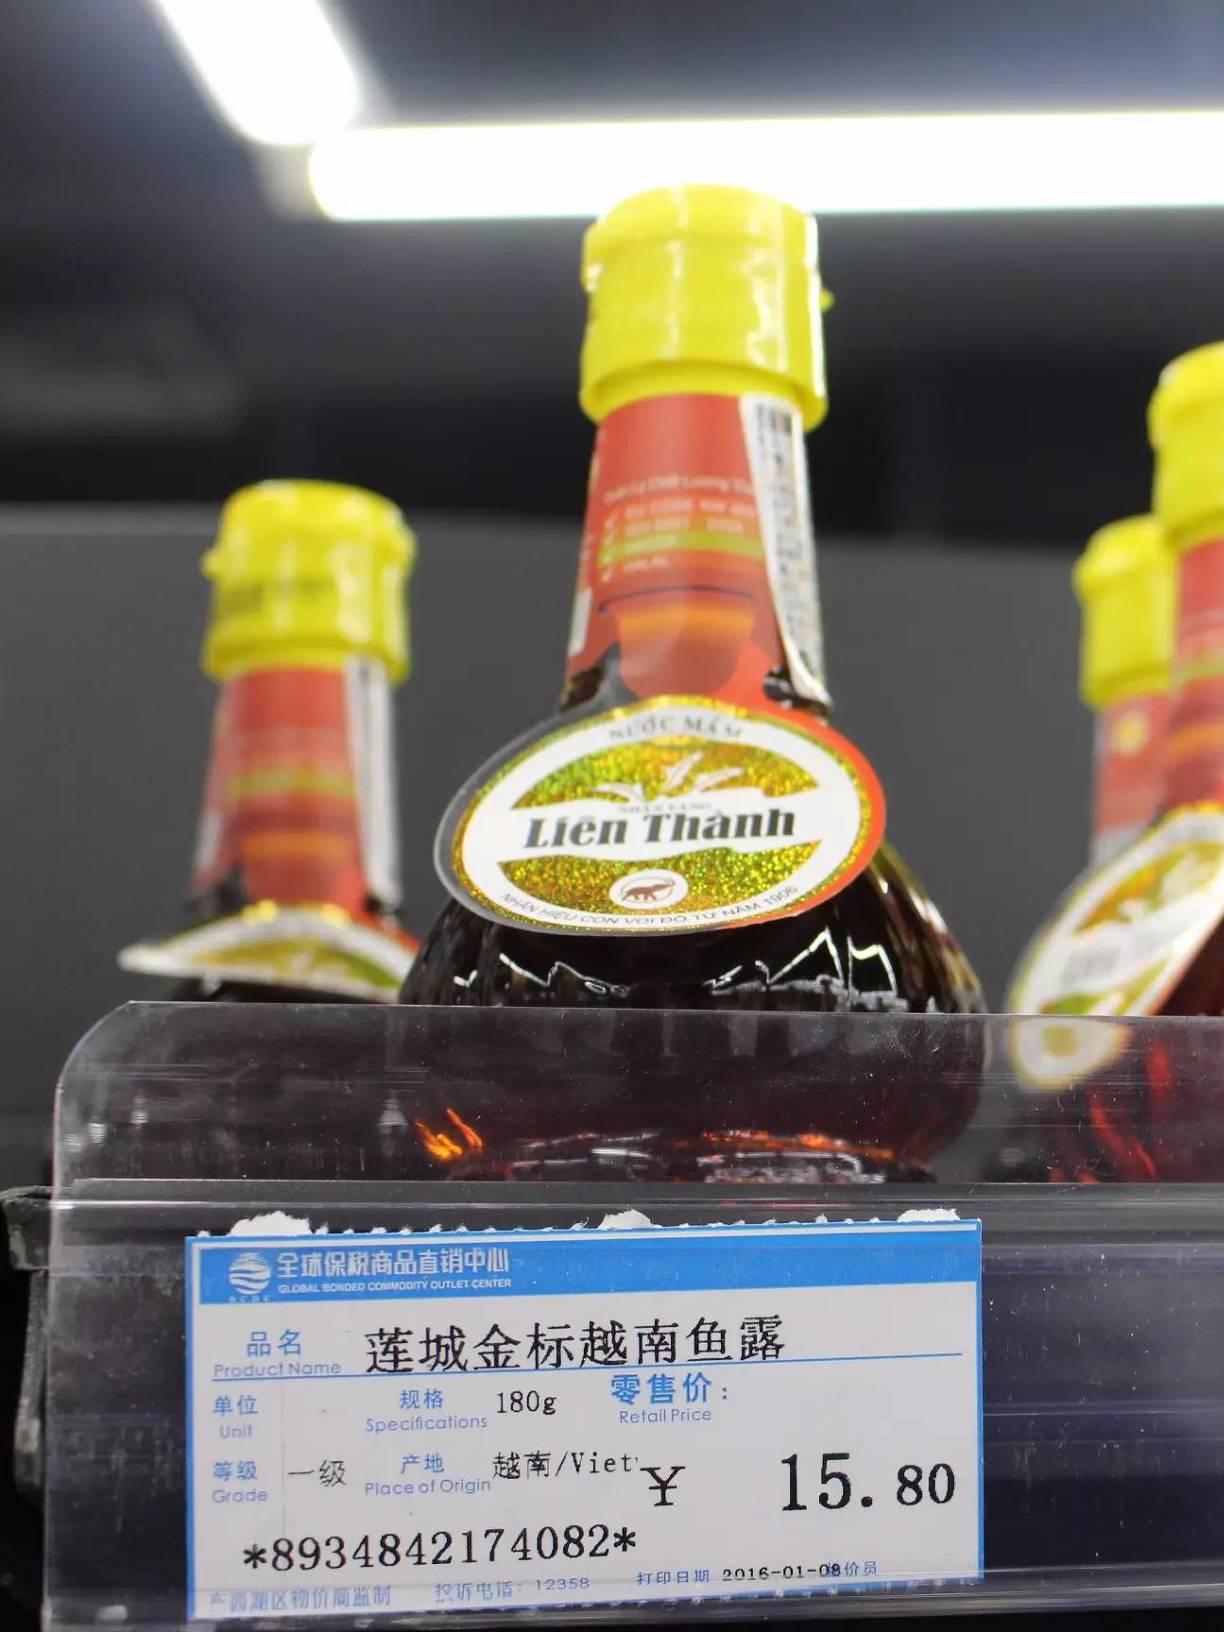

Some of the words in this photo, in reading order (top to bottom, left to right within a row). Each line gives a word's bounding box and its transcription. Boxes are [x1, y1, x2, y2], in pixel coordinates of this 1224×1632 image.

[523, 815, 627, 849] Liên
[278, 1247, 510, 1278] 全球保税商品直销中心
[278, 1284, 320, 1294] GLOBAL
[323, 1283, 365, 1293] BONDED
[367, 1281, 428, 1292] COMMODITY
[430, 1280, 470, 1290] OUTLET
[471, 1278, 512, 1288] CENTER
[246, 1329, 303, 1357] 品名
[364, 1313, 786, 1374] 莲城金标越南鱼露
[214, 1363, 285, 1377] Product
[287, 1361, 342, 1375] Name
[213, 1394, 259, 1416] 单位
[400, 1388, 444, 1410] 规格
[496, 1390, 557, 1416] 180g
[365, 1414, 488, 1434] Specifications
[619, 1409, 667, 1424] Retail
[671, 1408, 712, 1422] Price
[219, 1425, 253, 1439] Unit
[213, 1459, 258, 1481] 等级
[288, 1459, 347, 1488] 一级
[400, 1453, 445, 1475] 产地
[492, 1450, 640, 1480] 越南/Viet
[211, 1488, 269, 1503] Grade
[364, 1482, 415, 1496] Place
[418, 1480, 436, 1494] of
[439, 1478, 492, 1496] Origin
[536, 1577, 590, 1591] 12358
[636, 1569, 711, 1586] 打印日期
[722, 1563, 840, 1582] 2016-01-08
